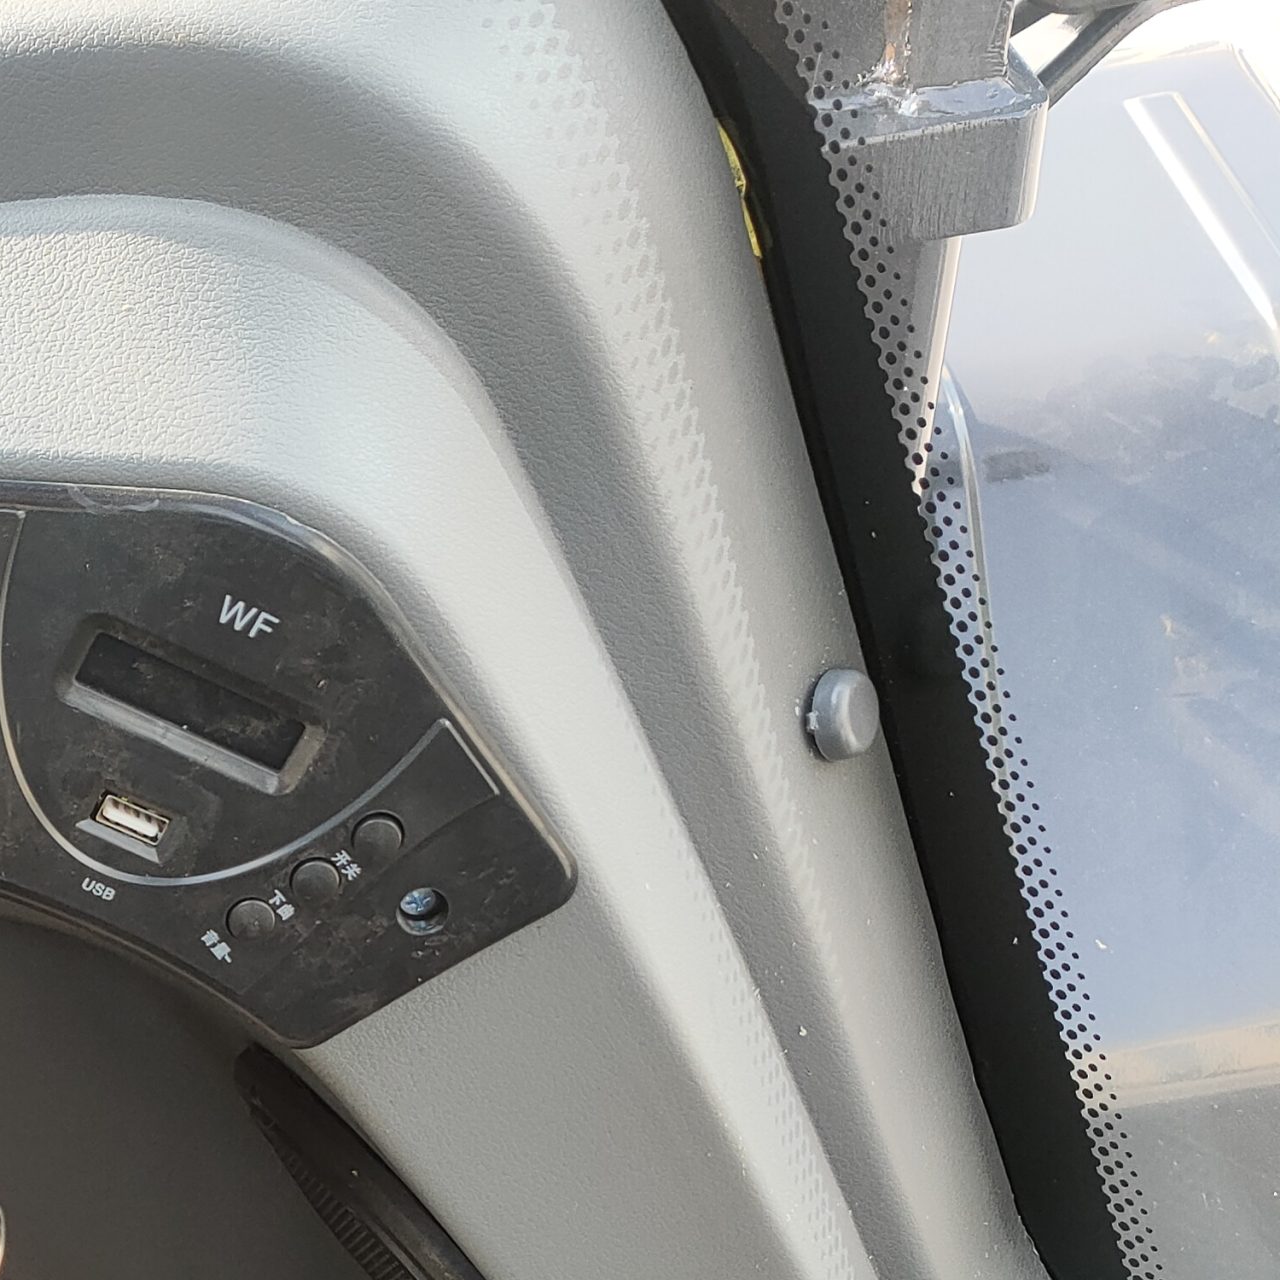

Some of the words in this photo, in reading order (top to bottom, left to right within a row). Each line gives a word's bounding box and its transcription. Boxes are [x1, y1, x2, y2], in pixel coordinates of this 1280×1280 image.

[219, 594, 280, 638] WF
[330, 850, 362, 881] 开关
[81, 877, 116, 901] USB
[268, 889, 296, 921] 下曲
